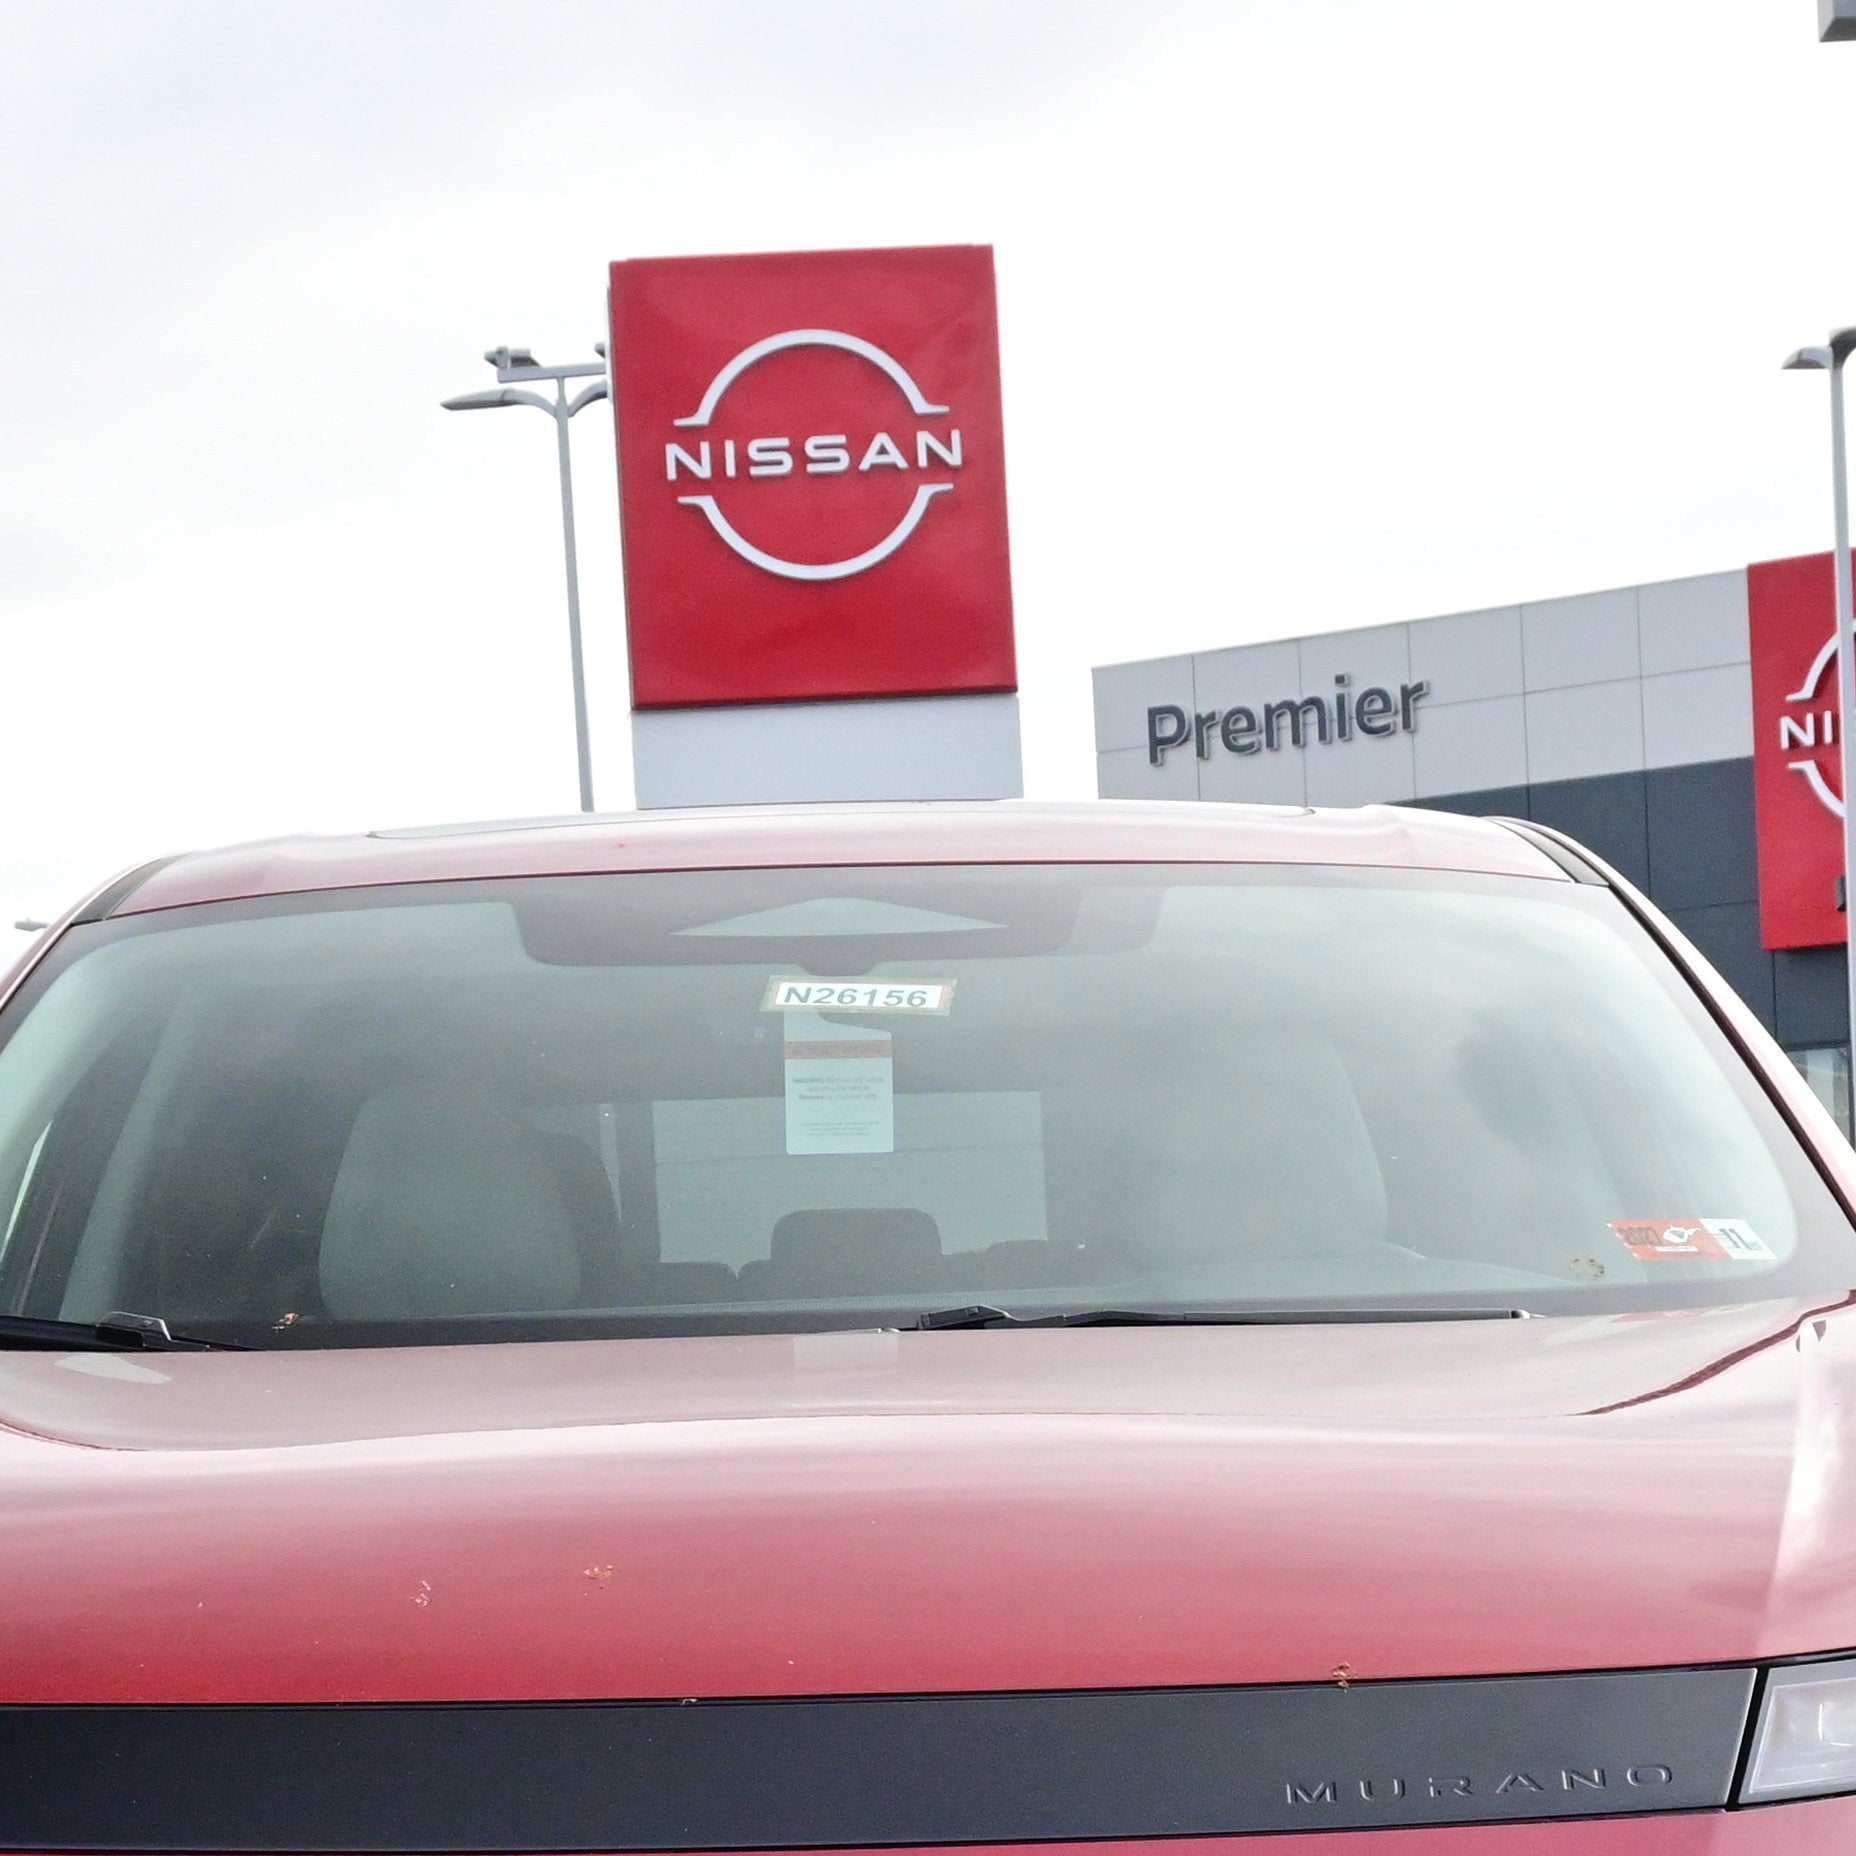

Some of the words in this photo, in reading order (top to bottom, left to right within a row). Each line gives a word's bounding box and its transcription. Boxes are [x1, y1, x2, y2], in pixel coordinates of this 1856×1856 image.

[665, 429, 963, 482] NISSAN
[1147, 674, 1430, 766] Premier
[784, 986, 928, 1007] N26156
[1285, 1764, 1674, 1804] MURANO
